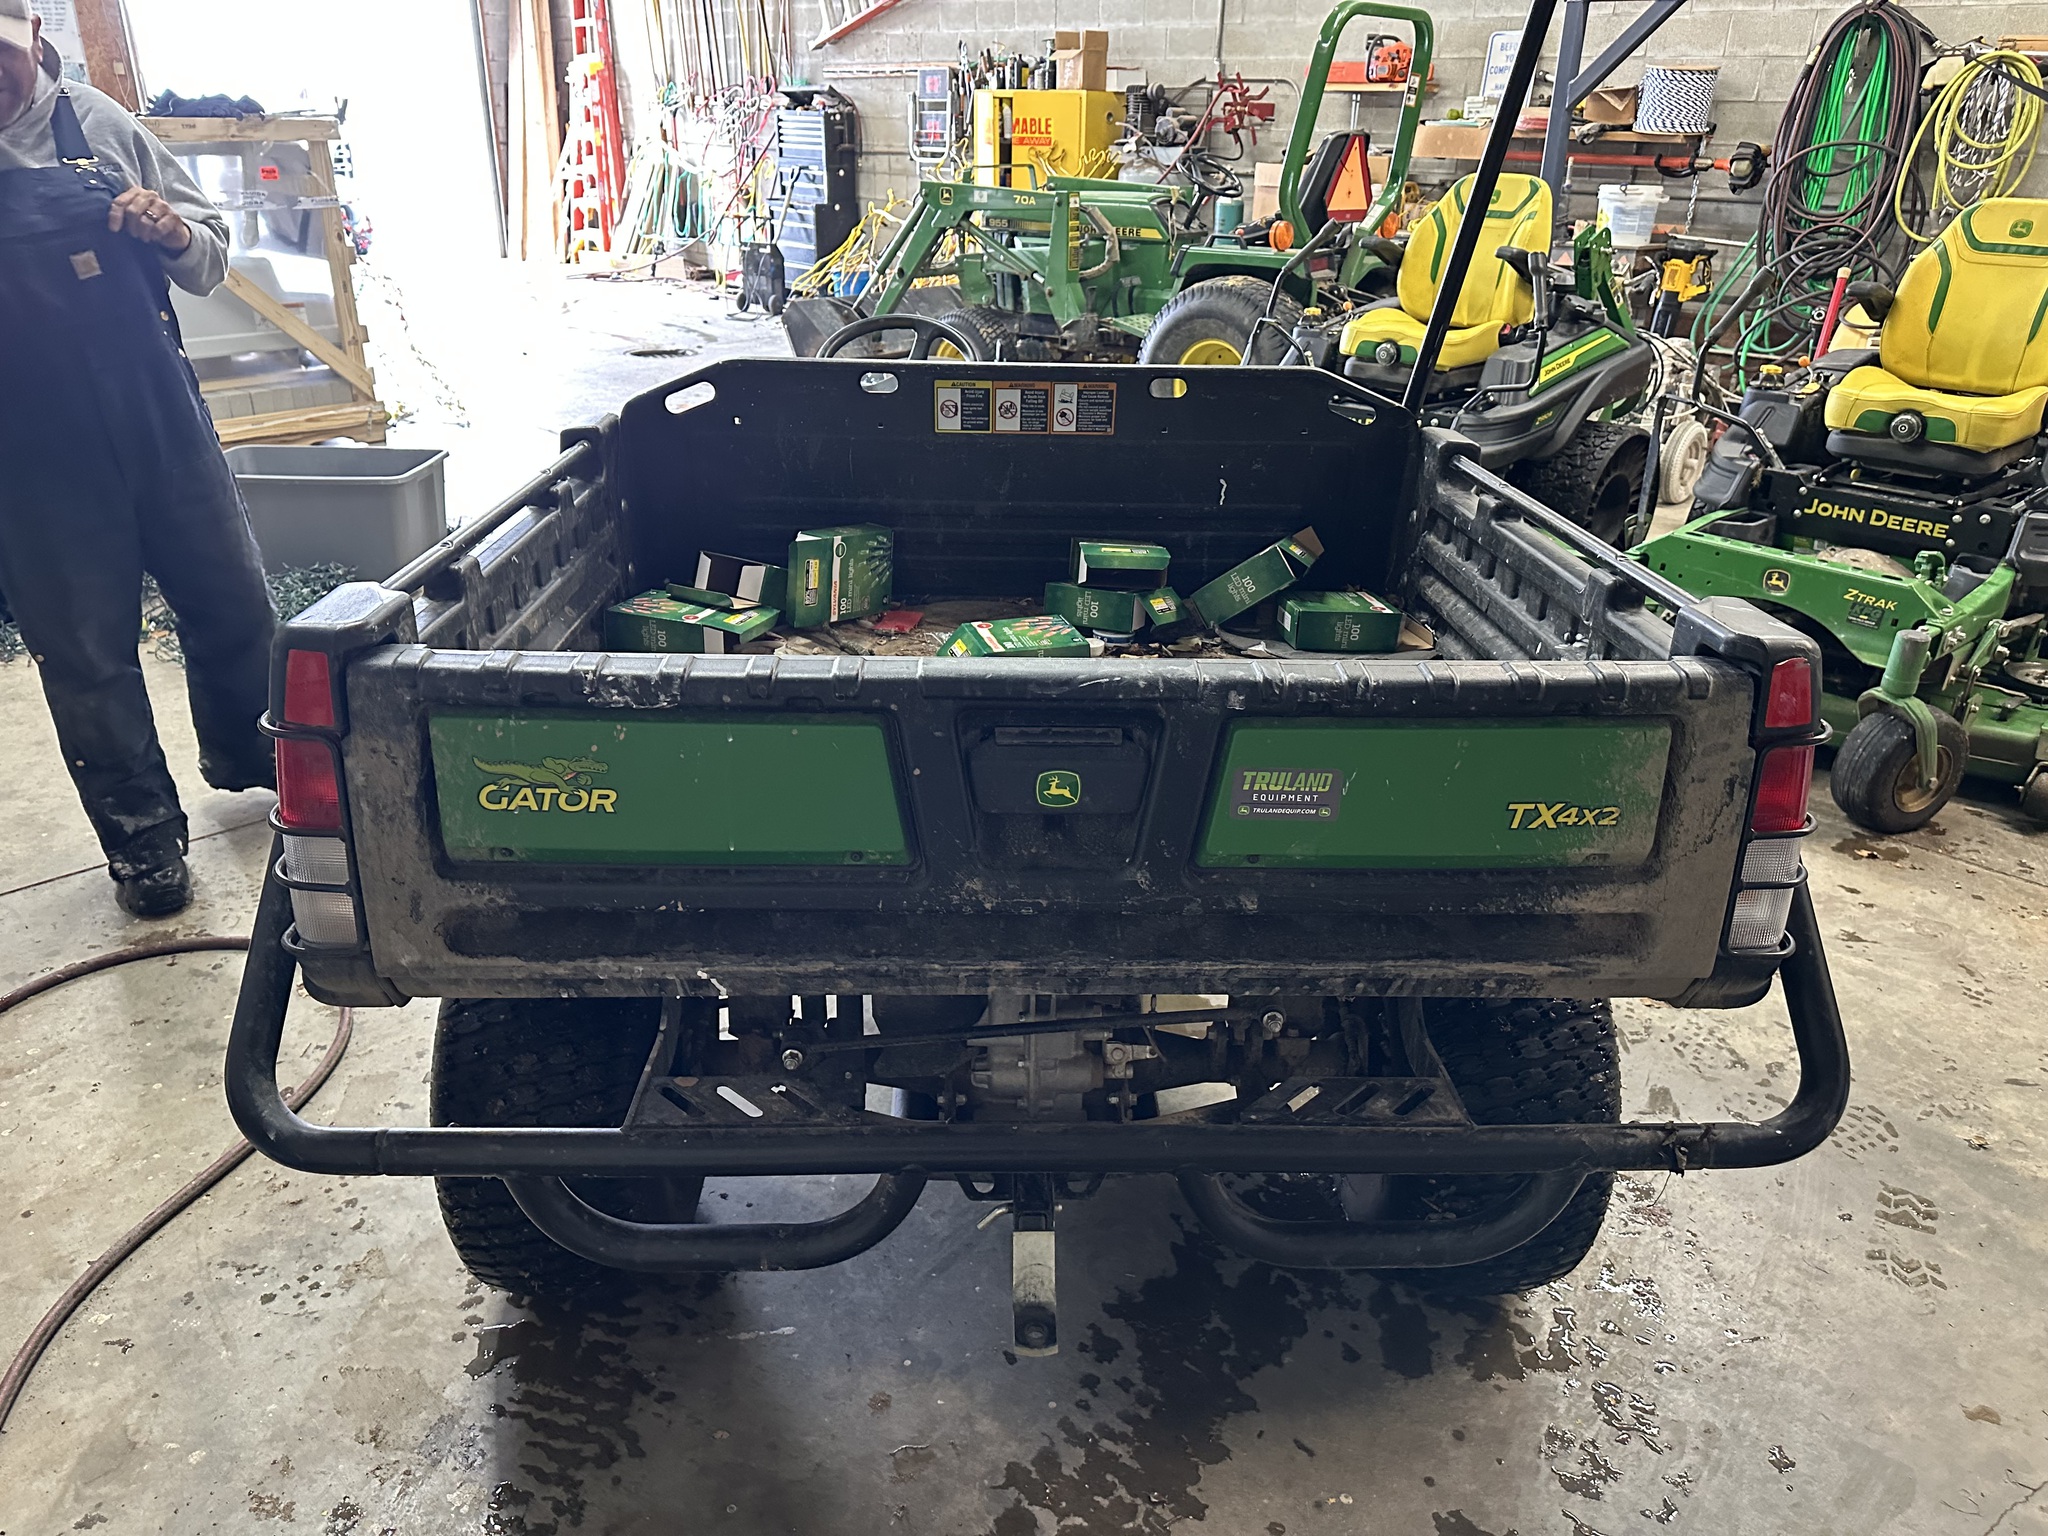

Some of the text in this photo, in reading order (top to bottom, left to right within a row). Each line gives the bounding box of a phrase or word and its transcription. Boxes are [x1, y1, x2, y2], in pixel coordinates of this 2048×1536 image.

[1023, 137, 1051, 145] AWAY
[1013, 194, 1036, 206] 70A
[989, 217, 1009, 229] 955
[1077, 225, 1142, 237] JOH EERE
[1543, 357, 1571, 377] JOHN DEERE
[1804, 498, 1950, 539] JOHN DEERE
[1227, 582, 1241, 602] lights
[1230, 572, 1251, 605] LED mini
[1241, 575, 1256, 593] 100
[839, 597, 847, 615] 100
[1075, 596, 1084, 618] lights
[1084, 591, 1092, 606] LED
[1843, 588, 1899, 611] ZTRAK
[1089, 601, 1099, 618] 100
[649, 619, 657, 635] LED
[1334, 621, 1344, 642] lights
[1341, 614, 1353, 649] LED mini
[1350, 624, 1361, 641] 100
[657, 630, 667, 647] 100
[1242, 771, 1333, 792] TRULAND
[479, 783, 618, 813] GATOR
[1252, 793, 1319, 802] EQUIPMENT
[1252, 807, 1317, 815] TRULANDEQUIP.COM
